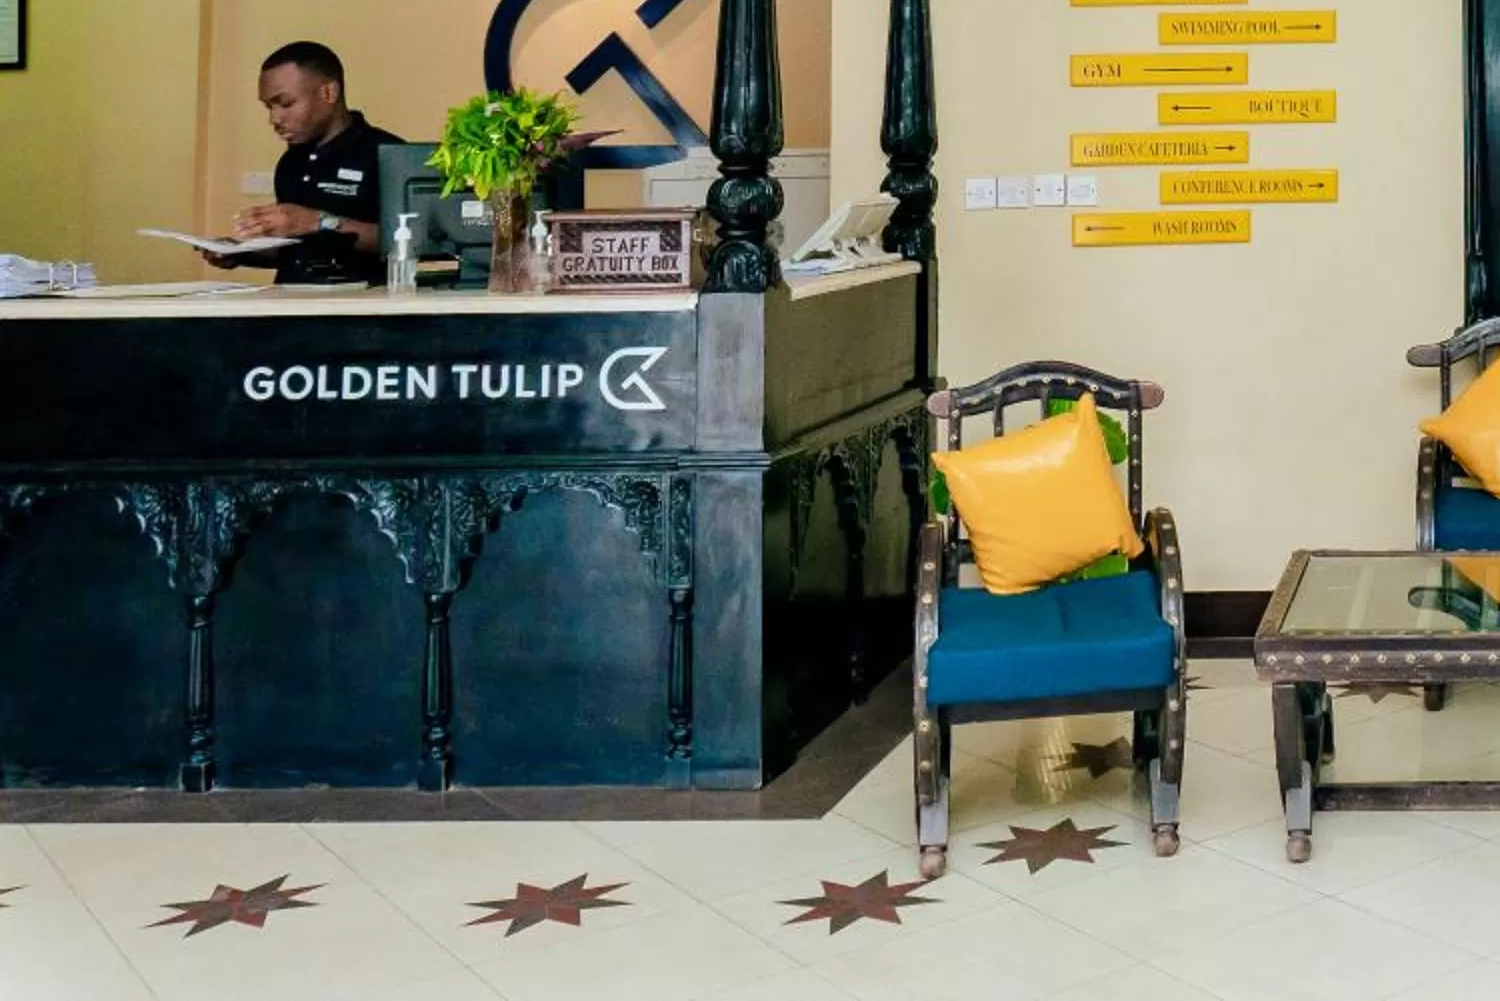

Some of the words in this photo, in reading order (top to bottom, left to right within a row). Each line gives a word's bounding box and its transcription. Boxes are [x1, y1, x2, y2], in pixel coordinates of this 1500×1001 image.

[1171, 19, 1243, 35] SWIMMING
[1246, 19, 1280, 35] POOL
[1083, 63, 1121, 79] GYM
[1248, 99, 1323, 119] BOUTIQUE
[1083, 142, 1136, 158] GARDEN
[1138, 141, 1208, 157] CAFETERIA
[1172, 179, 1257, 194] CONFERENCE
[1259, 179, 1304, 193] ROOMS
[591, 237, 650, 254] STAFF
[562, 255, 645, 272] GRATUITY
[651, 254, 680, 271] BOX
[242, 363, 437, 401] GOLDEN
[452, 362, 584, 400] TULIP
